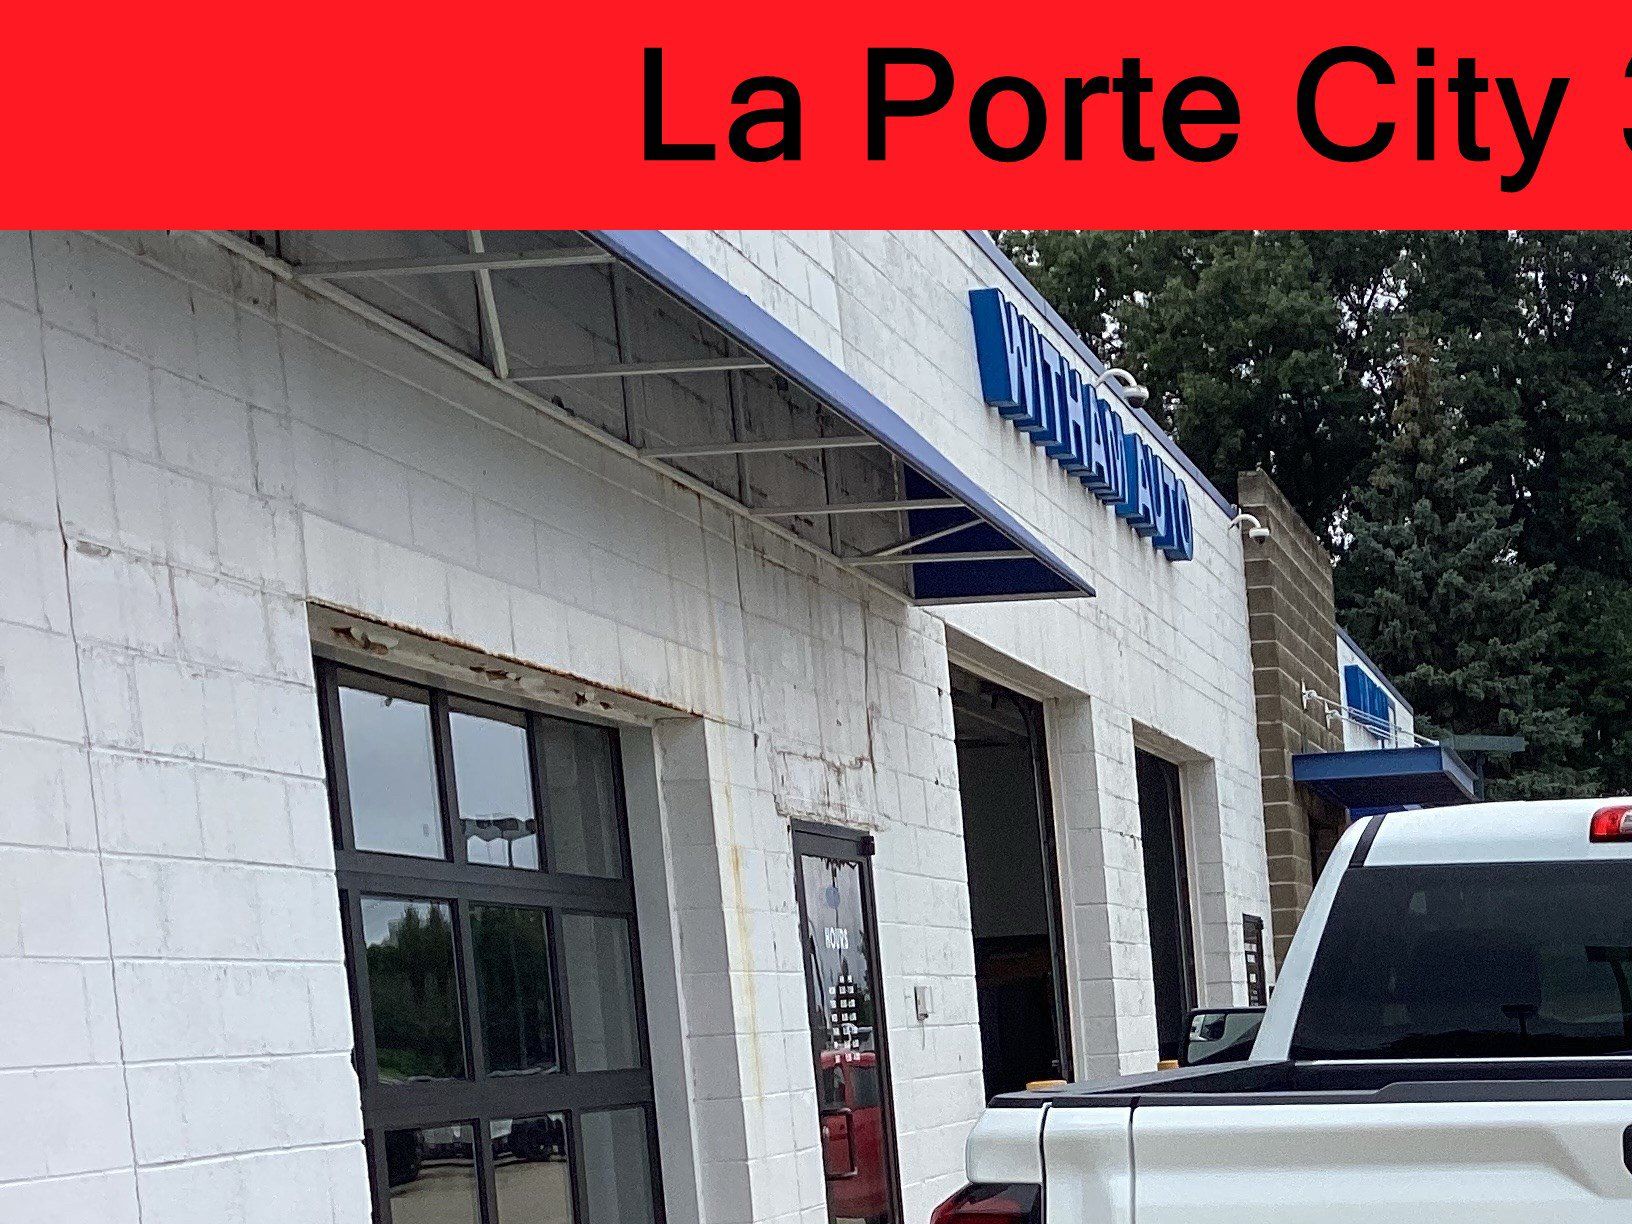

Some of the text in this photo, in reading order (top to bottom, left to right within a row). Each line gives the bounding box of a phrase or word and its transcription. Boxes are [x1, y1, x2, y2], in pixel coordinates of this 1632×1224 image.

[971, 288, 1194, 562] WITHAM AUTO
[824, 926, 850, 951] HOURS
